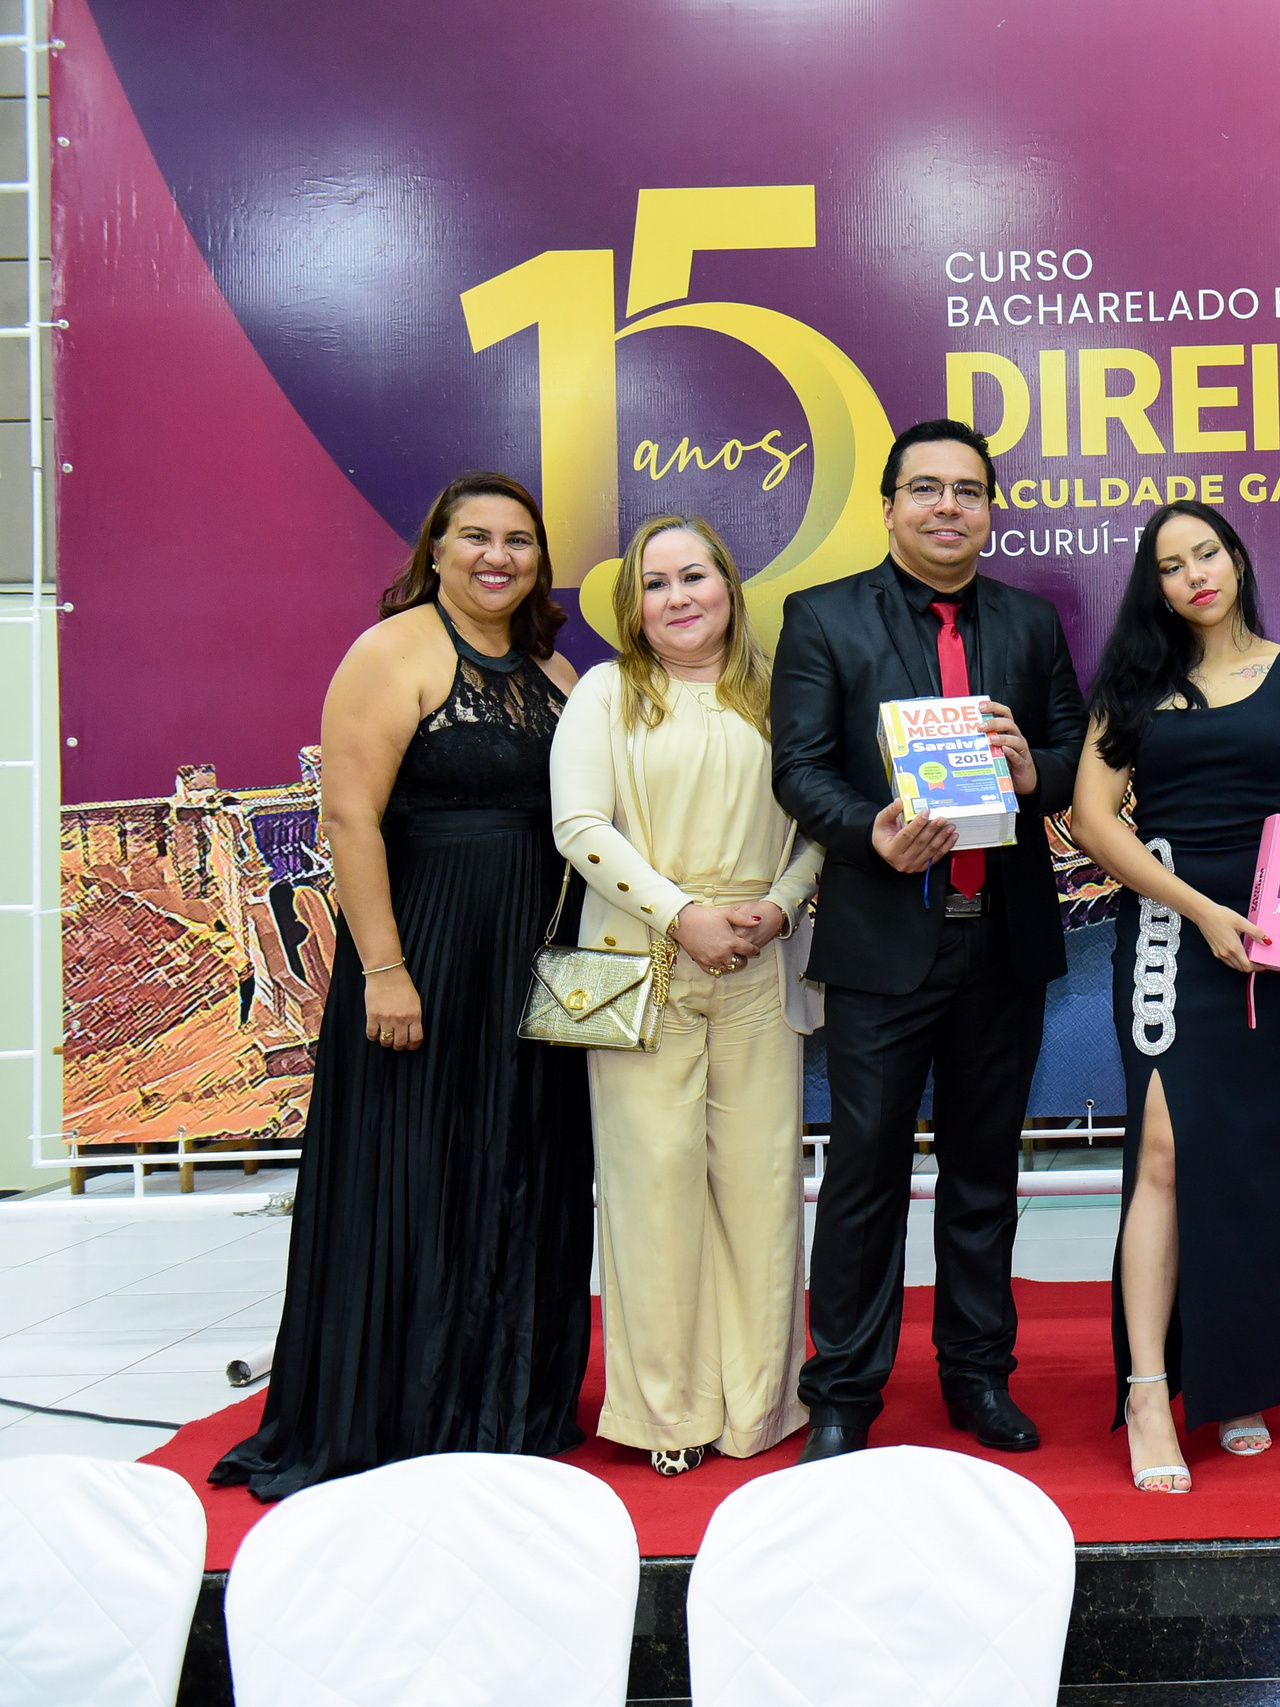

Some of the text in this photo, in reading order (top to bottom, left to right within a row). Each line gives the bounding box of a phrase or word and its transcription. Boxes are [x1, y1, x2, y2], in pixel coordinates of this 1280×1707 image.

[945, 248, 1093, 283] CURSO
[947, 286, 1260, 328] BACHARELADO
[460, 185, 896, 656] 15
[632, 428, 808, 492] anos
[991, 474, 1224, 510] ACULDADE
[902, 705, 978, 726] VADE
[907, 722, 983, 738] MECUM
[954, 753, 989, 765] 2015
